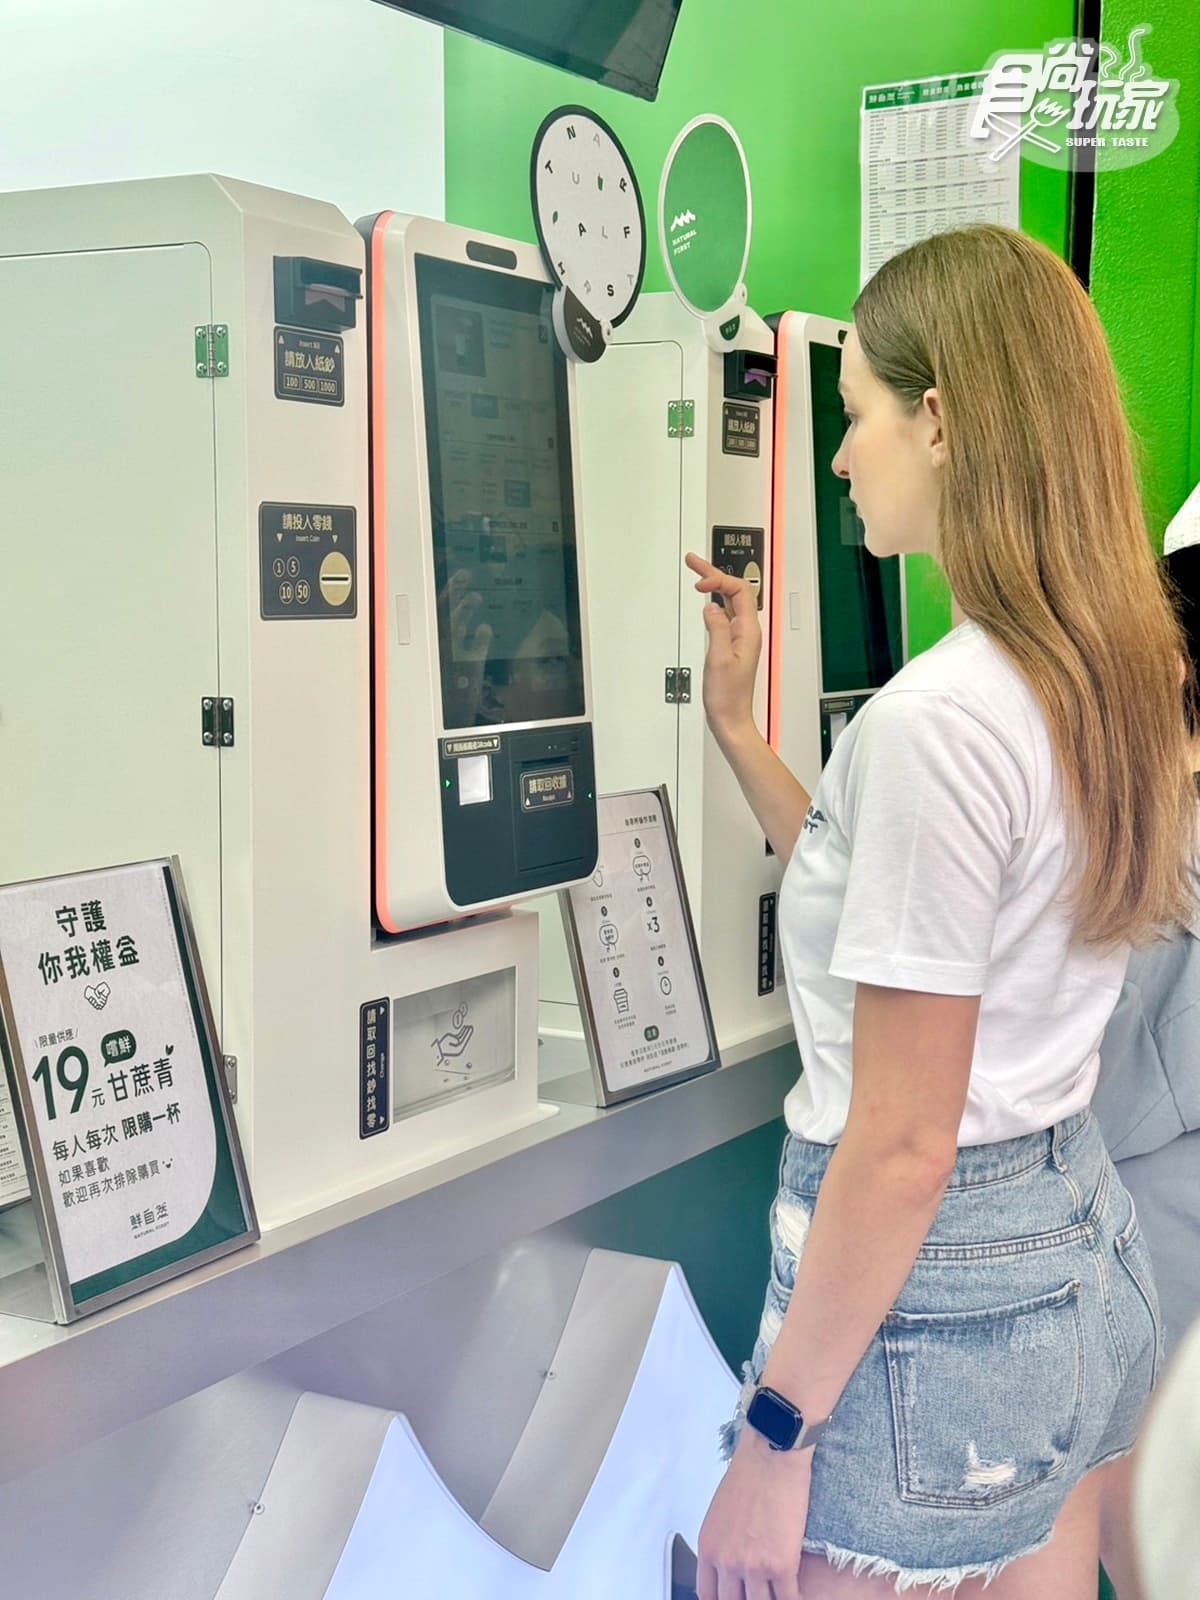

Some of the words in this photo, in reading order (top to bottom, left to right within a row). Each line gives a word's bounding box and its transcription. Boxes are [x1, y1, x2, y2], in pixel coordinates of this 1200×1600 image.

[566, 126, 576, 140] N
[545, 160, 553, 174] T
[571, 171, 580, 185] U
[578, 222, 587, 237] A
[601, 225, 608, 239] L
[623, 226, 631, 239] F
[672, 229, 697, 246] NATURAL
[607, 284, 614, 297] S
[286, 376, 298, 387] 100
[304, 378, 316, 390] 500
[320, 381, 336, 393] 1000
[291, 560, 296, 572] 5
[282, 587, 292, 599] 10
[297, 585, 308, 599] 50
[55, 899, 107, 938] 守護
[37, 935, 140, 985] 你我權益
[39, 1028, 75, 1047] 限量供應
[31, 1045, 89, 1121] 19
[91, 1088, 106, 1108] 元
[107, 1058, 174, 1102] 甘蔗青
[52, 1123, 118, 1161] 每人每次
[121, 1102, 181, 1140] 限購一杯
[58, 1156, 110, 1186] 如果喜歡
[129, 1201, 169, 1230] 鮮自然
